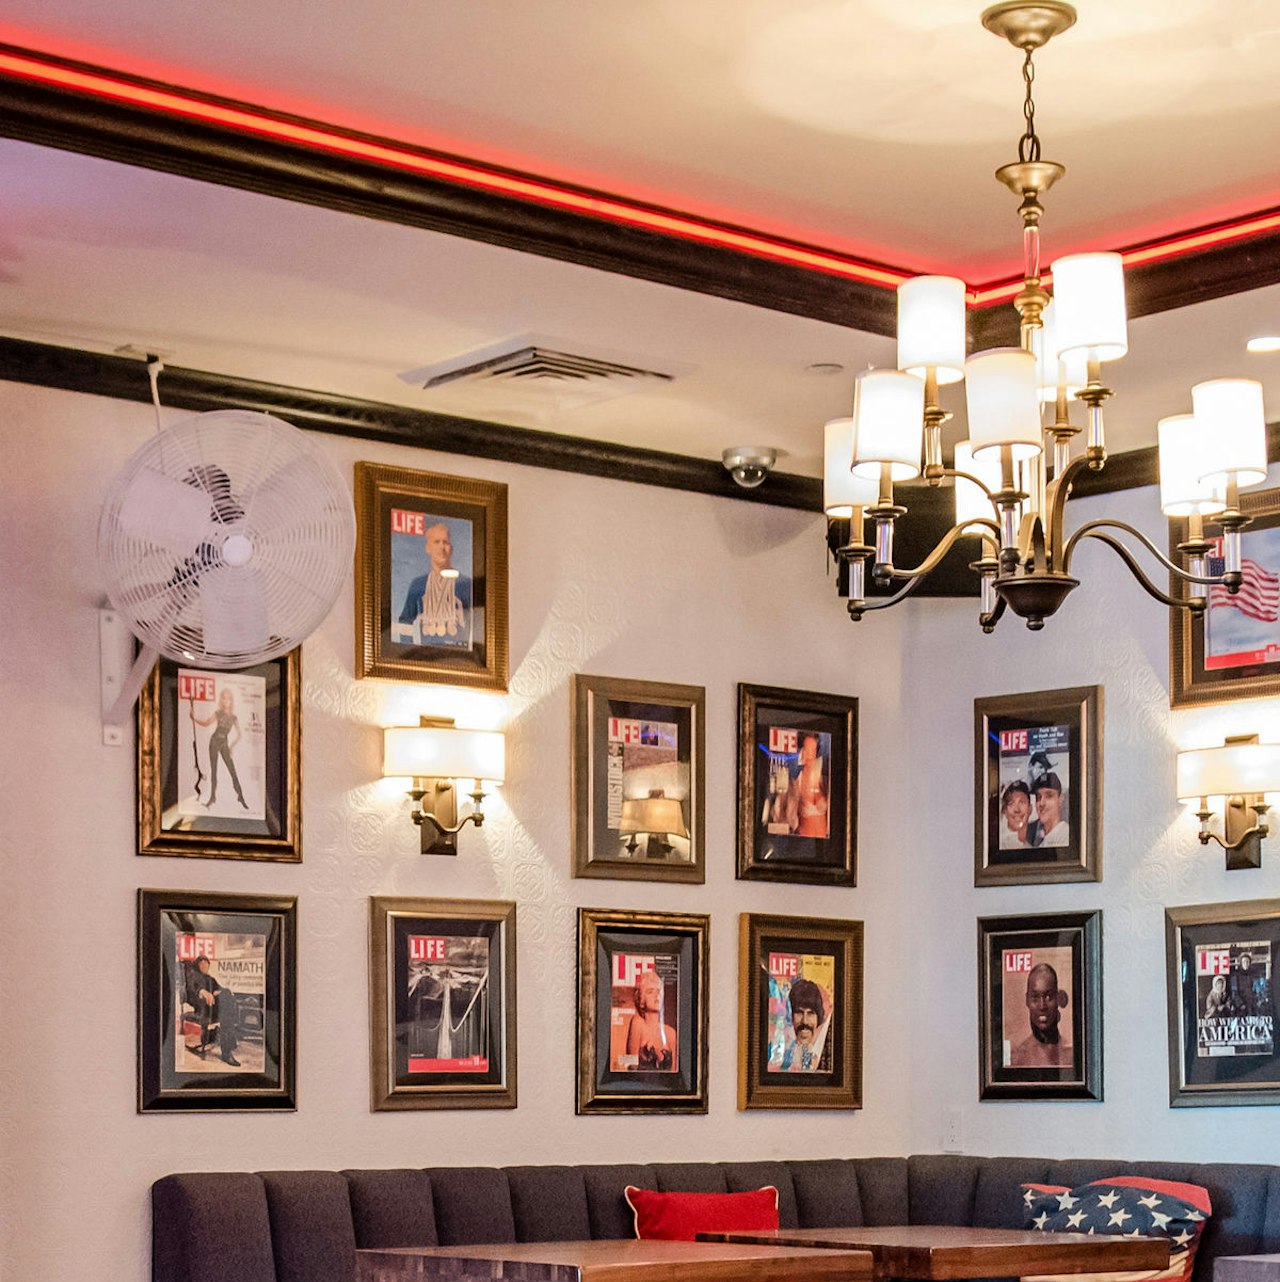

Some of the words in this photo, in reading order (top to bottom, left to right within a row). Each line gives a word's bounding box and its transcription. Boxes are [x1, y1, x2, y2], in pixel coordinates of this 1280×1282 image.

[393, 512, 424, 535] LIFE
[181, 677, 214, 700] LIFE
[609, 718, 639, 743] LIFE
[770, 727, 797, 753] LIFE
[1002, 732, 1027, 750] LIFE
[180, 937, 214, 959] LIFE
[411, 939, 444, 959] LIFE
[218, 962, 263, 972] NAMATH
[612, 955, 655, 986] LIFE
[771, 957, 797, 975] LIFE
[1006, 953, 1031, 971] LIFE
[1198, 950, 1230, 975] LIFE
[1200, 1025, 1271, 1041] AMERICA
